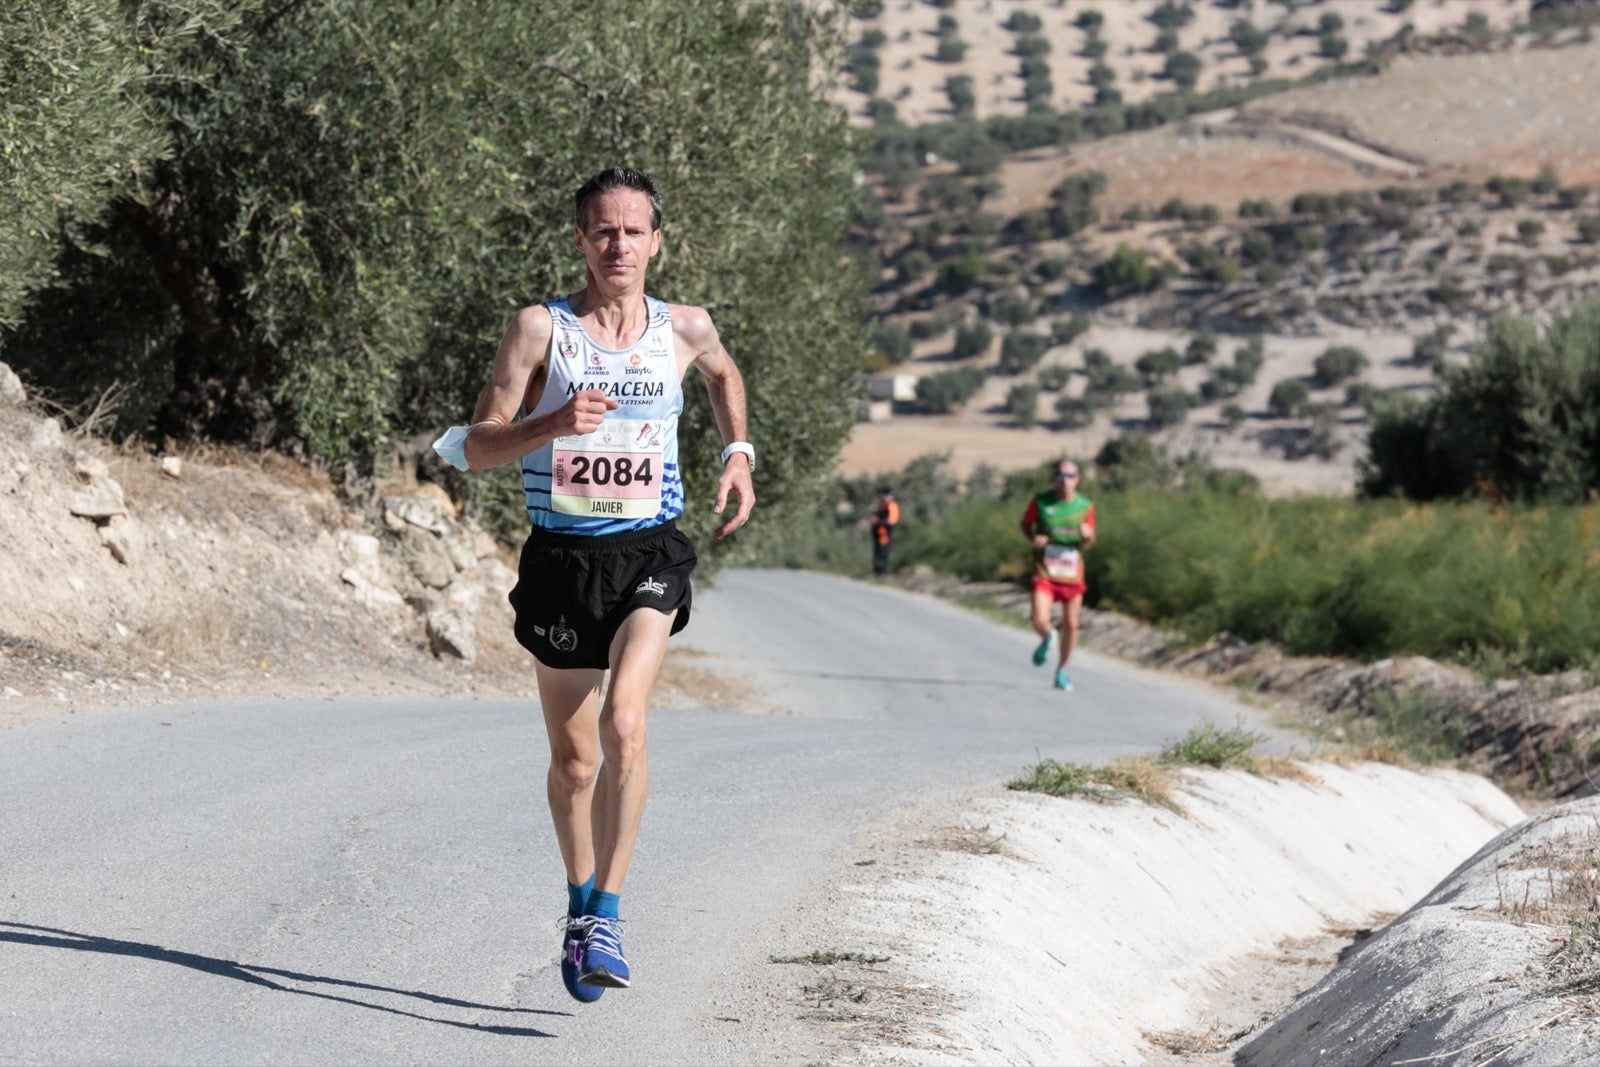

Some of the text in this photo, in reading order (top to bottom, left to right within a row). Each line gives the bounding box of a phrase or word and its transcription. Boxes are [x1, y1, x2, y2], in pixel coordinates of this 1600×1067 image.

[566, 381, 664, 397] MARACENA
[570, 456, 653, 487] 2084
[591, 501, 623, 514] JAVIER
